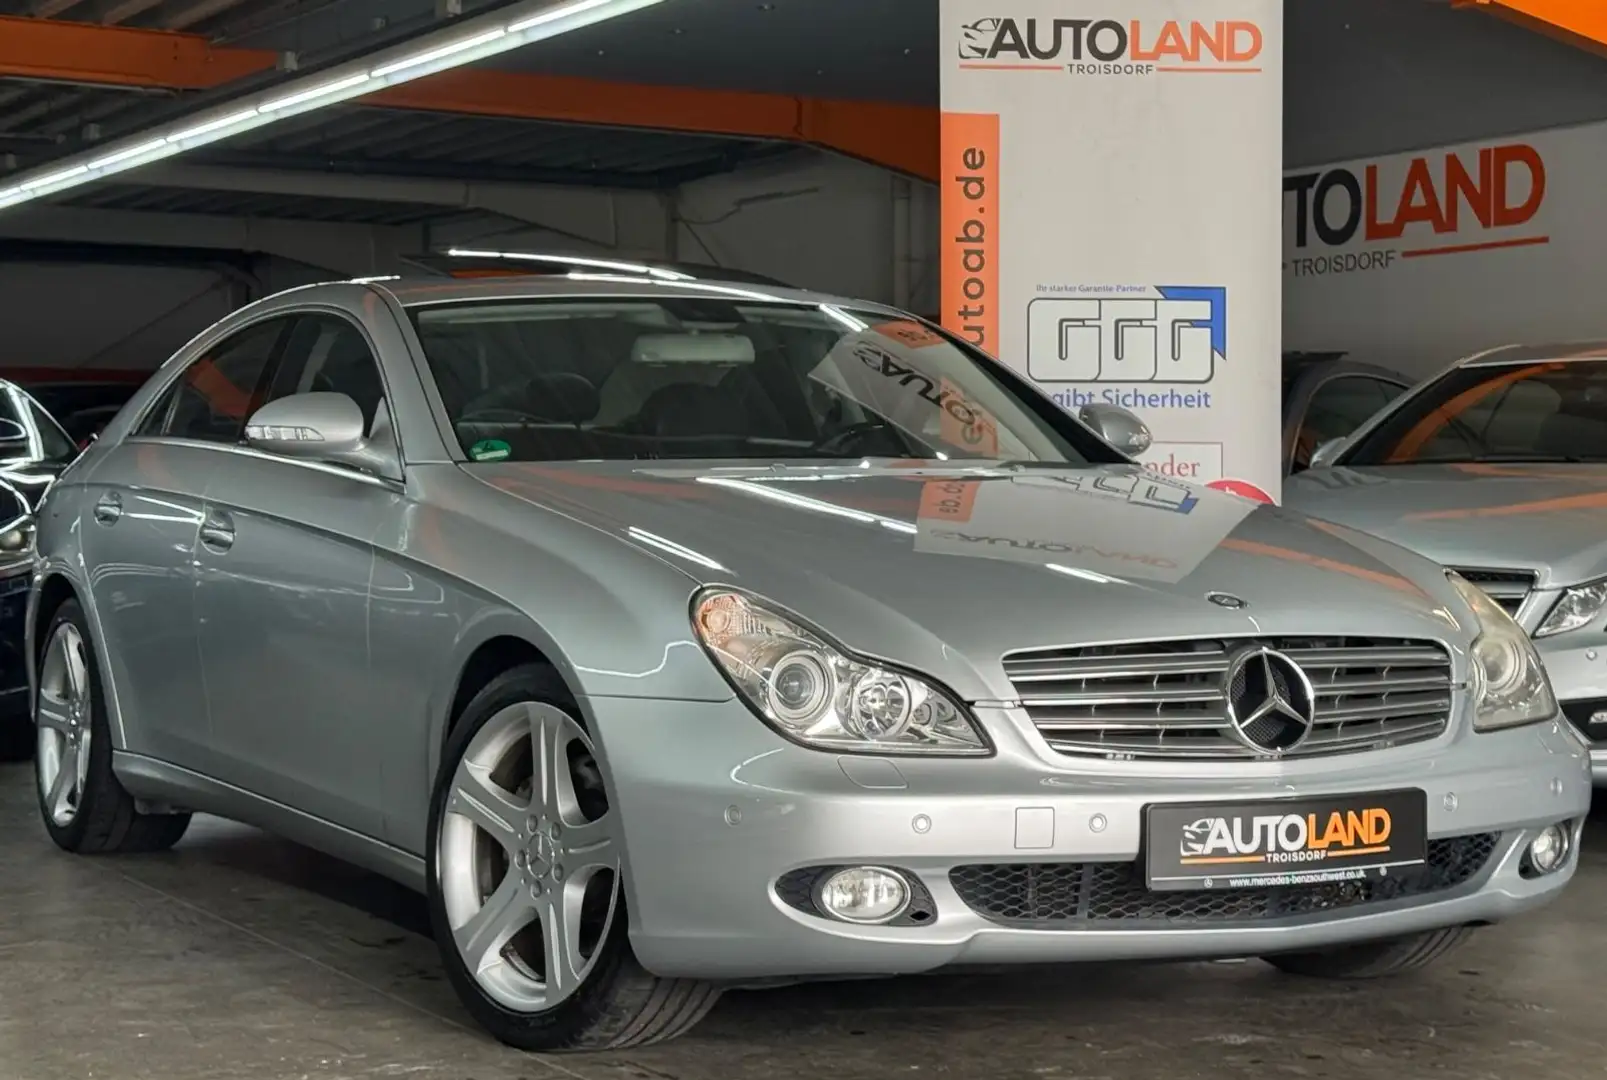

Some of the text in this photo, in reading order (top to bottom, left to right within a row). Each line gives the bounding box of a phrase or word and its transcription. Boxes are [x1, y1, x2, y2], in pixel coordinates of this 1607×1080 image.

[986, 18, 1262, 61] AUTOLAND
[1068, 63, 1153, 75] TROISDORF
[1283, 144, 1545, 247] TOLAND
[955, 147, 985, 345] utoab.de
[1292, 250, 1396, 277] TROISDORF
[1052, 388, 1211, 409] gibt Sicherheit
[1203, 808, 1391, 854] AUTOLAND
[1266, 850, 1327, 863] TROISDORF
